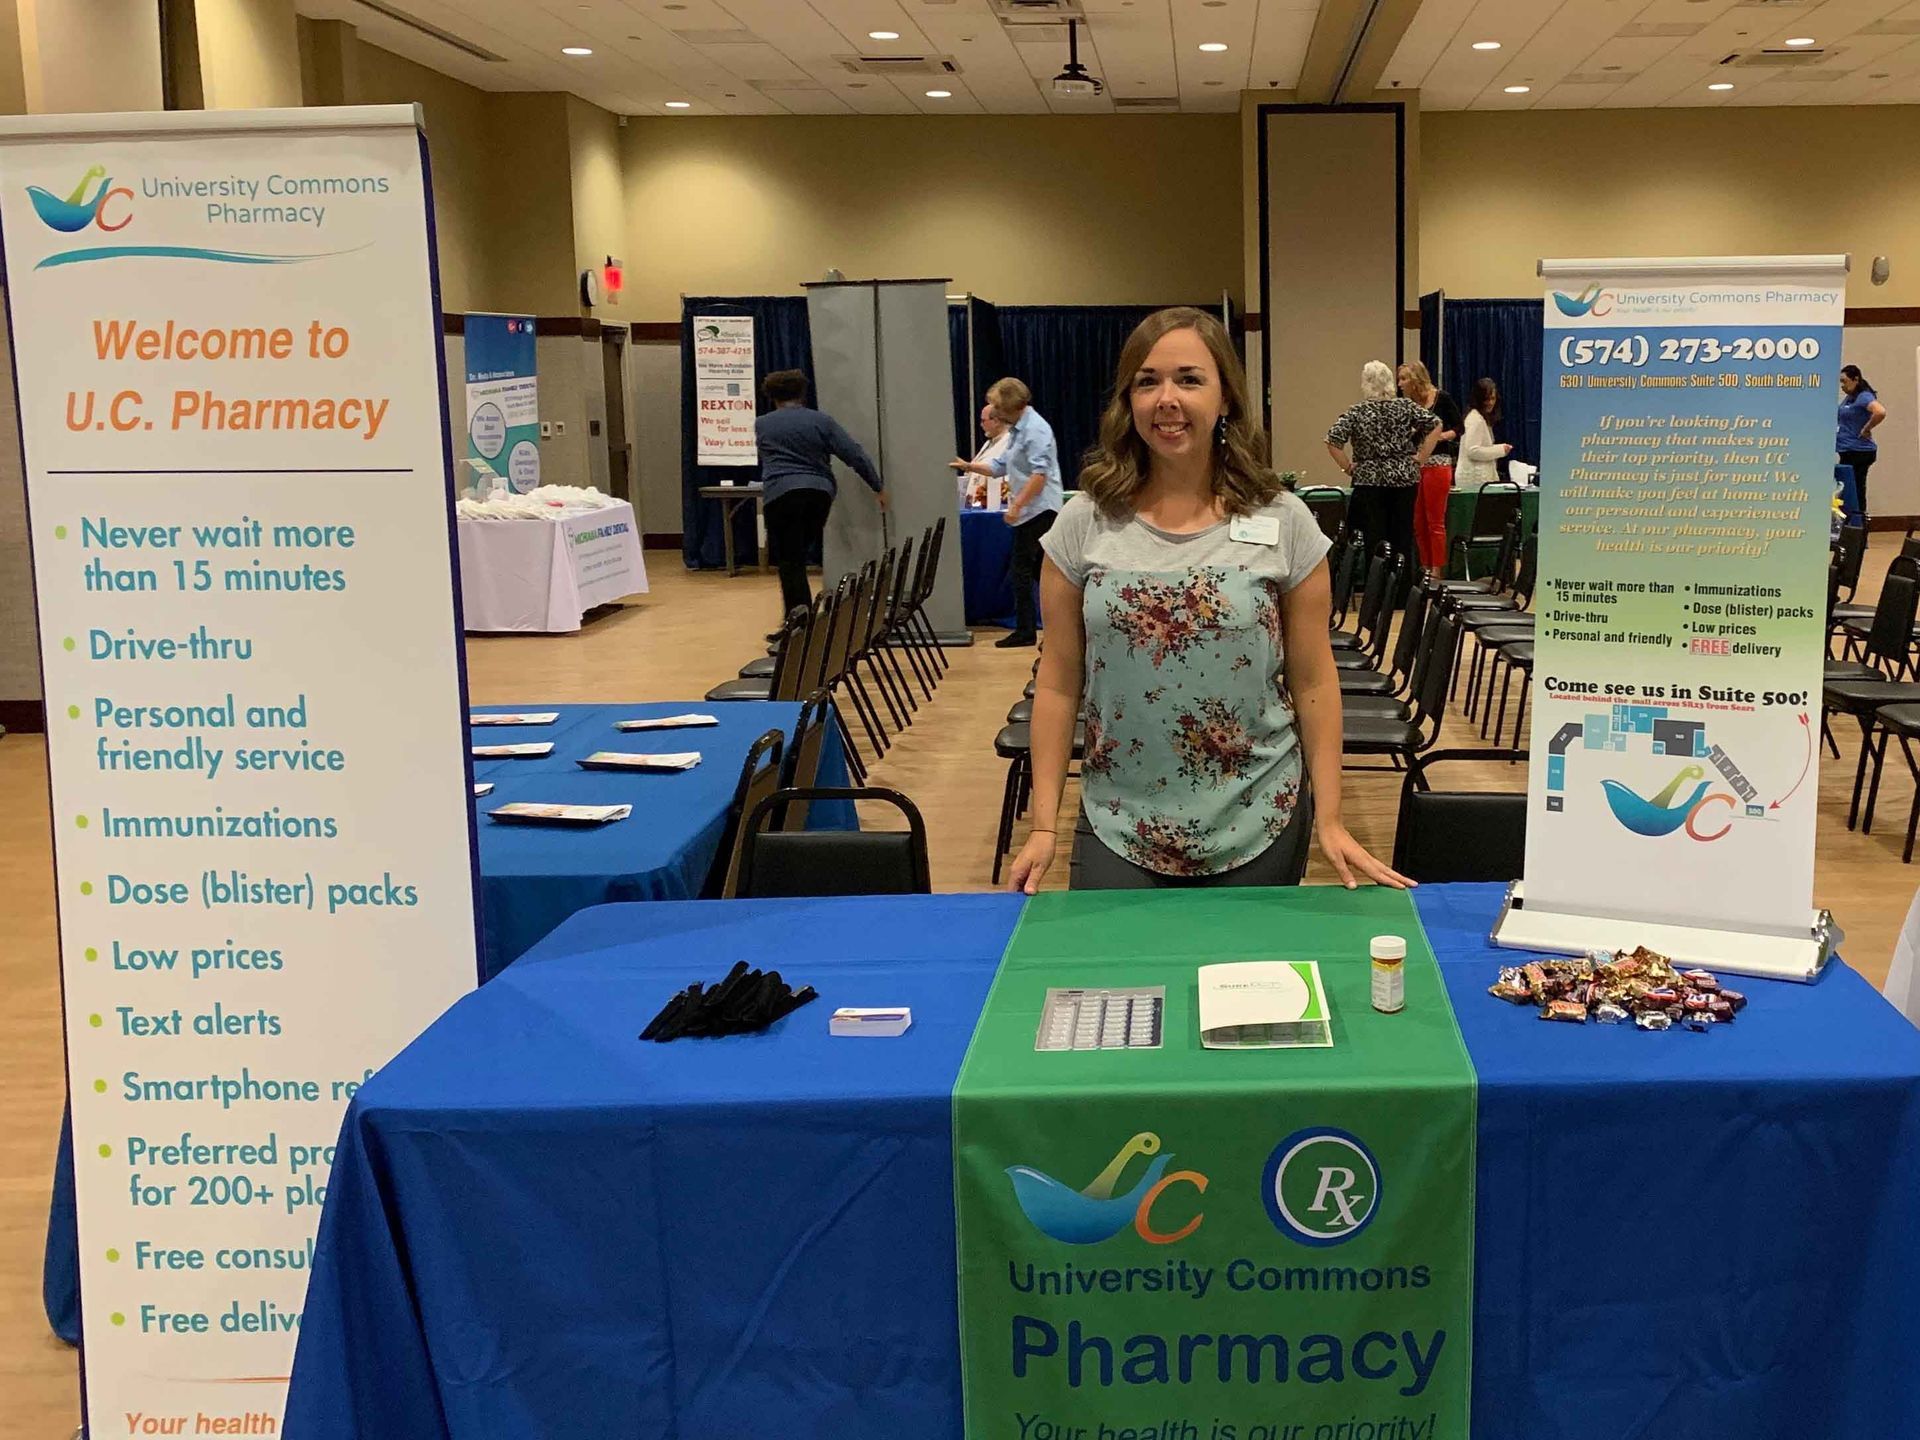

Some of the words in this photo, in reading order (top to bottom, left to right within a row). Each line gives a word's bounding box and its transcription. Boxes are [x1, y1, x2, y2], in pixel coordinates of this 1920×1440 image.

[141, 176, 260, 201] University
[267, 174, 390, 196] Commons
[207, 202, 325, 227] Pharmacy
[1617, 292, 1686, 308] University
[1689, 291, 1761, 304] Commons
[1765, 291, 1838, 306] Pharmacy
[93, 320, 293, 361] Welcome
[308, 321, 350, 360] to
[1559, 335, 1650, 368] (574)
[1659, 337, 1821, 365] 273-2000
[1560, 374, 1584, 388] 6301
[1587, 374, 1637, 390] University
[1640, 374, 1687, 388] Commons
[1690, 374, 1715, 387] Suite
[1745, 374, 1774, 388] South
[1777, 374, 1805, 390] Bend,
[1809, 374, 1821, 387] IN
[66, 391, 153, 431] U.C.
[172, 391, 390, 440] Pharmacy
[701, 400, 753, 410] REXTON
[1600, 415, 1617, 431] If
[1616, 416, 1665, 431] you're
[1669, 415, 1729, 431] looking
[1731, 415, 1758, 431] for
[1762, 418, 1772, 428] a
[1581, 433, 1662, 449] pharmacy
[1665, 433, 1697, 446] that
[1702, 434, 1753, 447] makes
[1758, 436, 1789, 449] you
[1581, 451, 1619, 464] their
[1622, 452, 1648, 467] top
[1651, 452, 1719, 467] priority,
[1723, 452, 1760, 465] then
[1765, 452, 1790, 465] UC
[1569, 468, 1650, 483] Pharmacy
[1653, 469, 1667, 482] is
[1669, 469, 1700, 484] just
[1702, 469, 1727, 485] for
[1732, 471, 1769, 485] you!
[1774, 471, 1800, 484] We
[1560, 486, 1590, 499] will
[1591, 487, 1633, 499] make
[1638, 490, 1667, 503] you
[1669, 487, 1699, 503] feel
[1702, 489, 1718, 500] at
[1723, 488, 1767, 501] home
[1772, 489, 1809, 502] with
[1566, 506, 1591, 517] our
[1596, 505, 1665, 519] personal
[1668, 506, 1697, 518] and
[1702, 506, 1801, 521] experienced
[81, 517, 182, 549] Never
[193, 516, 262, 548] wait
[274, 524, 355, 548] more
[1621, 522, 1637, 535] At
[1642, 525, 1670, 536] our
[1765, 527, 1806, 541] your
[1596, 540, 1645, 553] health
[1650, 542, 1663, 553] is
[1665, 543, 1694, 554] our
[1696, 541, 1771, 558] priority!
[85, 558, 157, 592] than
[174, 560, 212, 591] 15
[225, 560, 346, 592] minutes
[1554, 578, 1585, 591] Never
[1589, 579, 1613, 592] wait
[1616, 582, 1644, 593] more
[1649, 581, 1675, 594] than
[1556, 592, 1569, 603] 15
[1572, 592, 1618, 604] minutes
[1694, 584, 1782, 598] Immunizations
[1553, 611, 1608, 624] Drive-thru
[1693, 603, 1722, 615] Dose
[1725, 604, 1774, 619] (blister)
[1777, 606, 1814, 620] packs
[90, 626, 252, 660] Drive-thru
[1553, 629, 1601, 643] Personal
[1603, 631, 1626, 643] and
[1628, 632, 1672, 647] friendly
[1692, 622, 1717, 634] Low
[1718, 623, 1757, 638] prices
[1691, 639, 1730, 655] FREE
[1732, 642, 1782, 658] delivery
[1544, 676, 1598, 694] Come
[1604, 682, 1635, 696] see
[1642, 684, 1665, 698] us
[1671, 684, 1695, 699] in
[1699, 685, 1755, 703] Suite
[1762, 690, 1809, 707] 500!
[1549, 693, 1581, 701] Located
[1583, 695, 1612, 703] behind
[1706, 702, 1728, 710] from
[95, 694, 235, 728] Personal
[247, 694, 307, 727] and
[97, 736, 223, 779] friendly
[236, 741, 345, 771] service
[103, 807, 337, 837] Immunizations
[108, 875, 189, 904] Dose
[202, 871, 314, 910] (blister)
[329, 873, 418, 914] packs
[113, 941, 178, 970] Low
[193, 939, 283, 978] prices
[116, 1007, 182, 1035] Text
[194, 1003, 281, 1035] alerts
[123, 1068, 319, 1109] Smartphone
[128, 1133, 278, 1166] Preferred
[130, 1175, 176, 1206] for
[188, 1175, 274, 1206] 200+
[136, 1241, 204, 1270] Free
[1009, 1260, 1214, 1299] University
[1226, 1259, 1431, 1292] Commons
[140, 1305, 208, 1333] Free
[1011, 1315, 1446, 1397] Pharmacy
[126, 1412, 187, 1435] Your
[195, 1412, 276, 1435] health
[1015, 1413, 1087, 1440] Your
[1099, 1418, 1198, 1440] health
[1211, 1418, 1236, 1440] is
[1248, 1425, 1304, 1440] our
[1313, 1413, 1437, 1440] priority!
